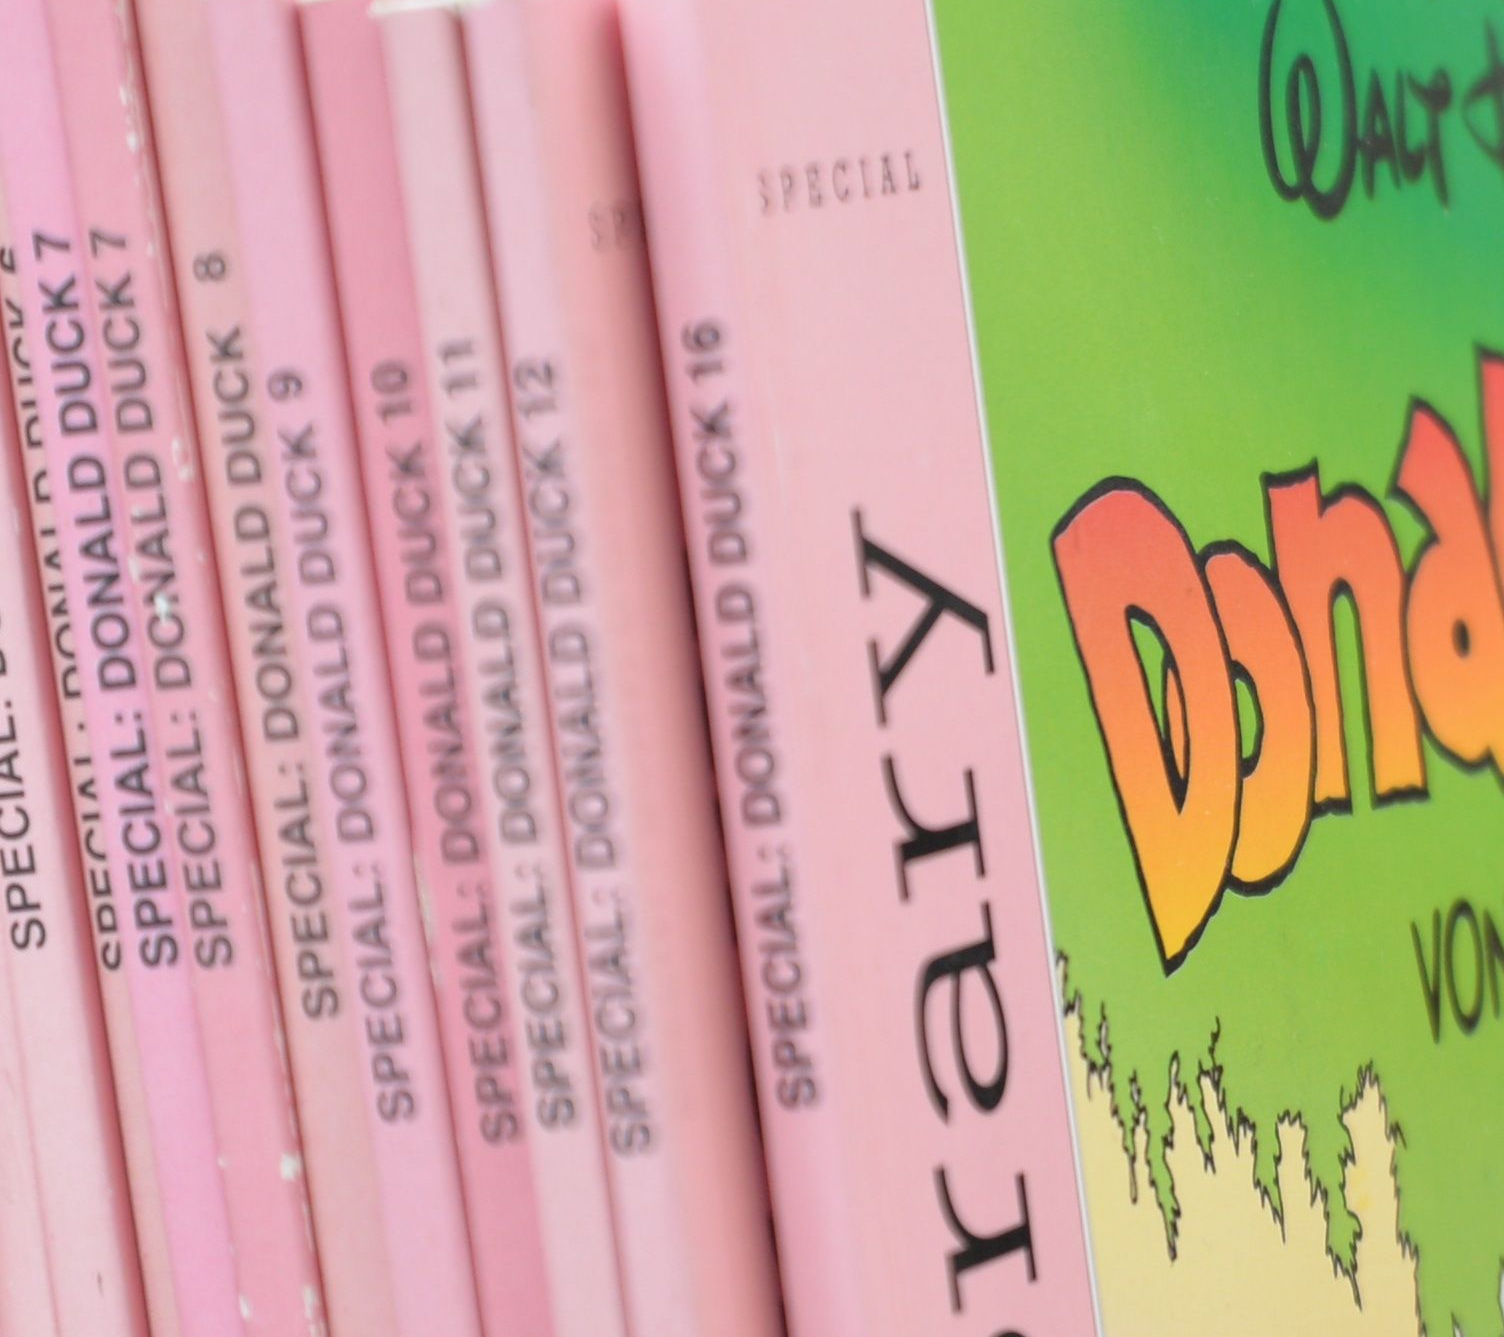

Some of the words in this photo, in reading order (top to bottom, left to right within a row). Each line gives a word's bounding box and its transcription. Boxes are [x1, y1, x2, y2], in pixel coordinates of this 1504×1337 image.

[31, 231, 71, 262] 7
[88, 227, 127, 259] 7
[193, 251, 228, 283] 8
[756, 148, 923, 218] SPECIAL
[37, 273, 99, 435] DUCK
[94, 272, 154, 434] DUCK
[205, 325, 263, 489] DUCK
[266, 367, 305, 402] 9
[369, 360, 413, 425] 10
[436, 337, 479, 400] 11
[511, 358, 559, 421] 12
[680, 319, 726, 385] 16
[275, 422, 338, 587] DUCK
[383, 439, 445, 607] DUCK
[442, 415, 504, 584] DUCK
[518, 436, 583, 609] DUCK
[688, 399, 750, 565] DUCK
[66, 454, 137, 691] DONALD
[123, 452, 192, 691] DONALD
[232, 504, 300, 743] DONALD
[304, 601, 376, 844] DONALD
[411, 620, 481, 866] DONALD
[470, 600, 539, 845] DONALD
[547, 621, 617, 869] DONALD
[714, 581, 784, 828] DONALD
[110, 710, 179, 968] SPECIAL:
[165, 710, 234, 970] SPECIAL:
[272, 763, 340, 1020] SPECIAL:
[346, 861, 417, 1126] SPECIAL:
[454, 881, 521, 1147] SPECIAL:
[509, 860, 577, 1132] SPECIAL:
[585, 888, 653, 1158] SPECIAL:
[752, 843, 821, 1112] SPECIAL:
